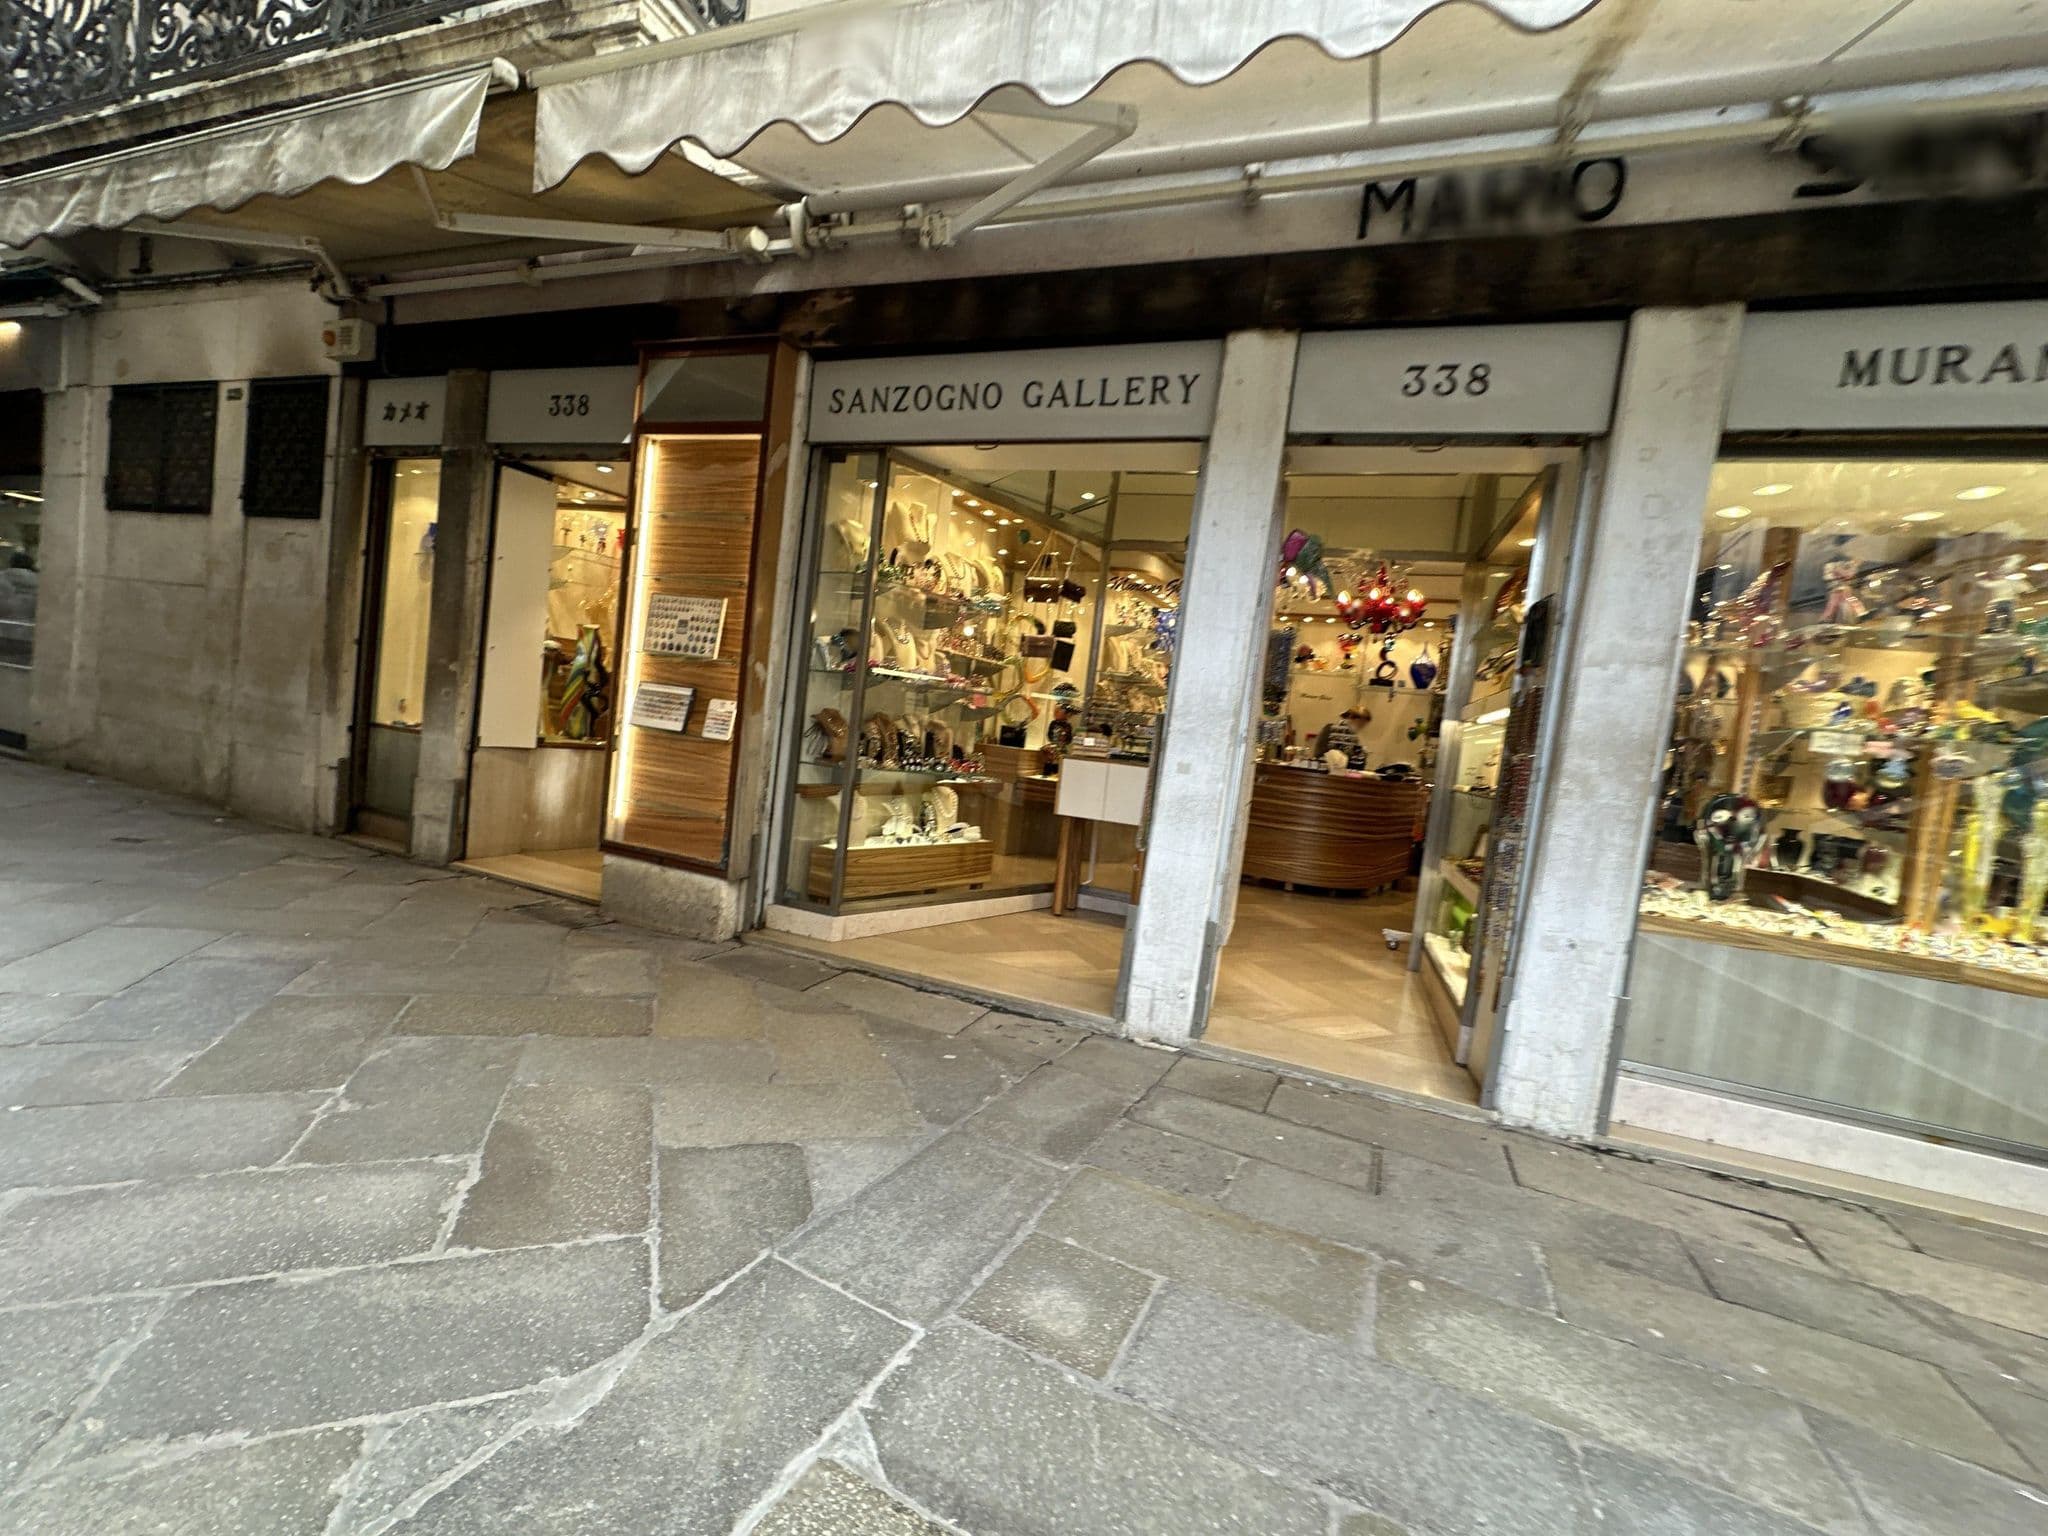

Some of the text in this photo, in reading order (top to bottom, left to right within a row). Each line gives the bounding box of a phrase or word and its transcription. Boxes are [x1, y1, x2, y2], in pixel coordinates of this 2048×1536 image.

[1355, 156, 1627, 240] MAO
[828, 373, 1201, 414] SANZOGNO GALLERY
[1401, 363, 1492, 397] 338
[382, 401, 431, 423] カメオ
[549, 394, 591, 417] 338
